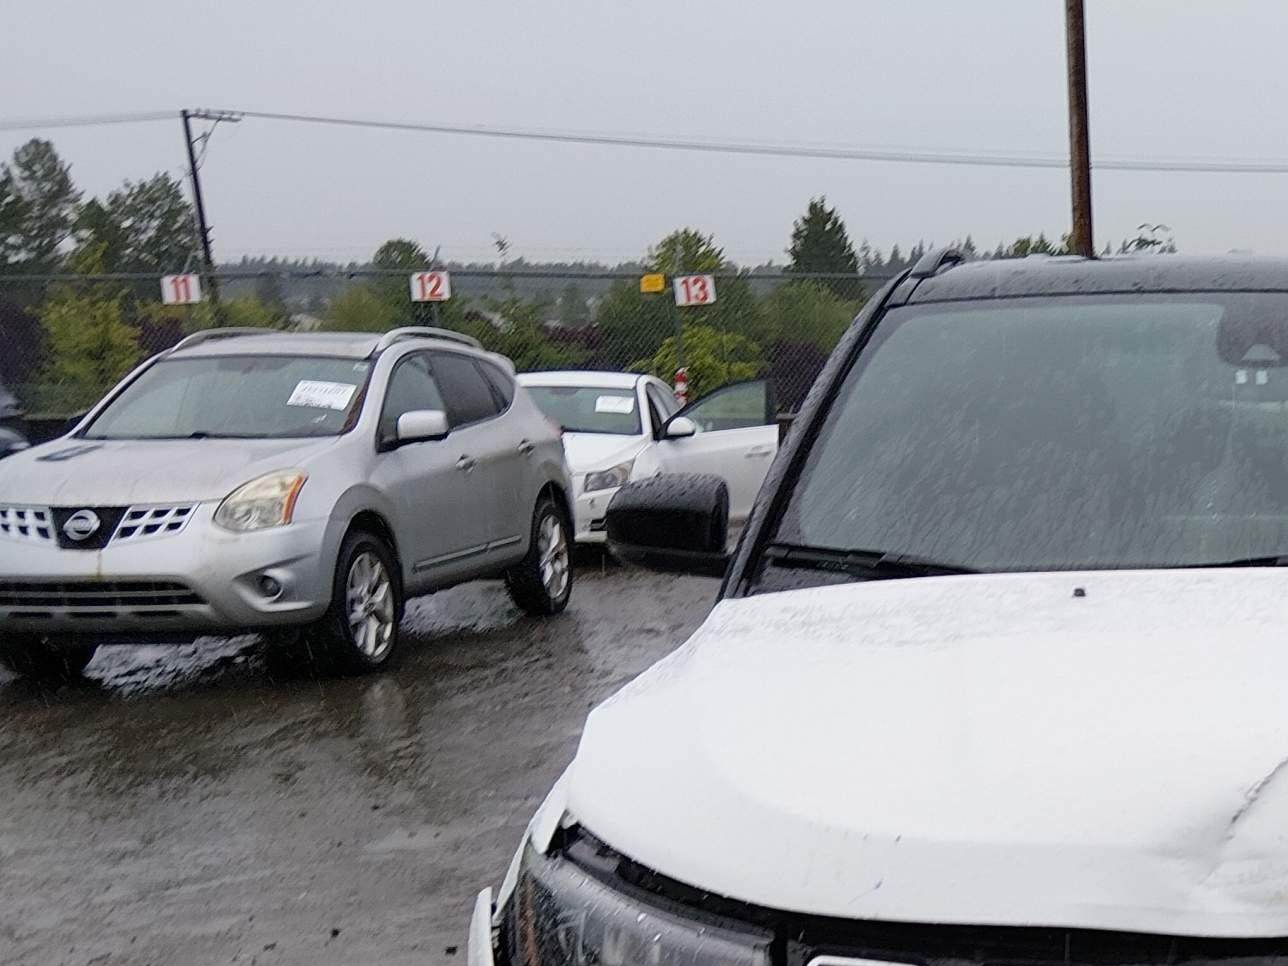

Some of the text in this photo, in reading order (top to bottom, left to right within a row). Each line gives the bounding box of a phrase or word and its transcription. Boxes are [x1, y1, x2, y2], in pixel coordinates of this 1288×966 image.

[170, 276, 191, 304] 11
[416, 273, 443, 300] 12
[681, 275, 708, 304] 13
